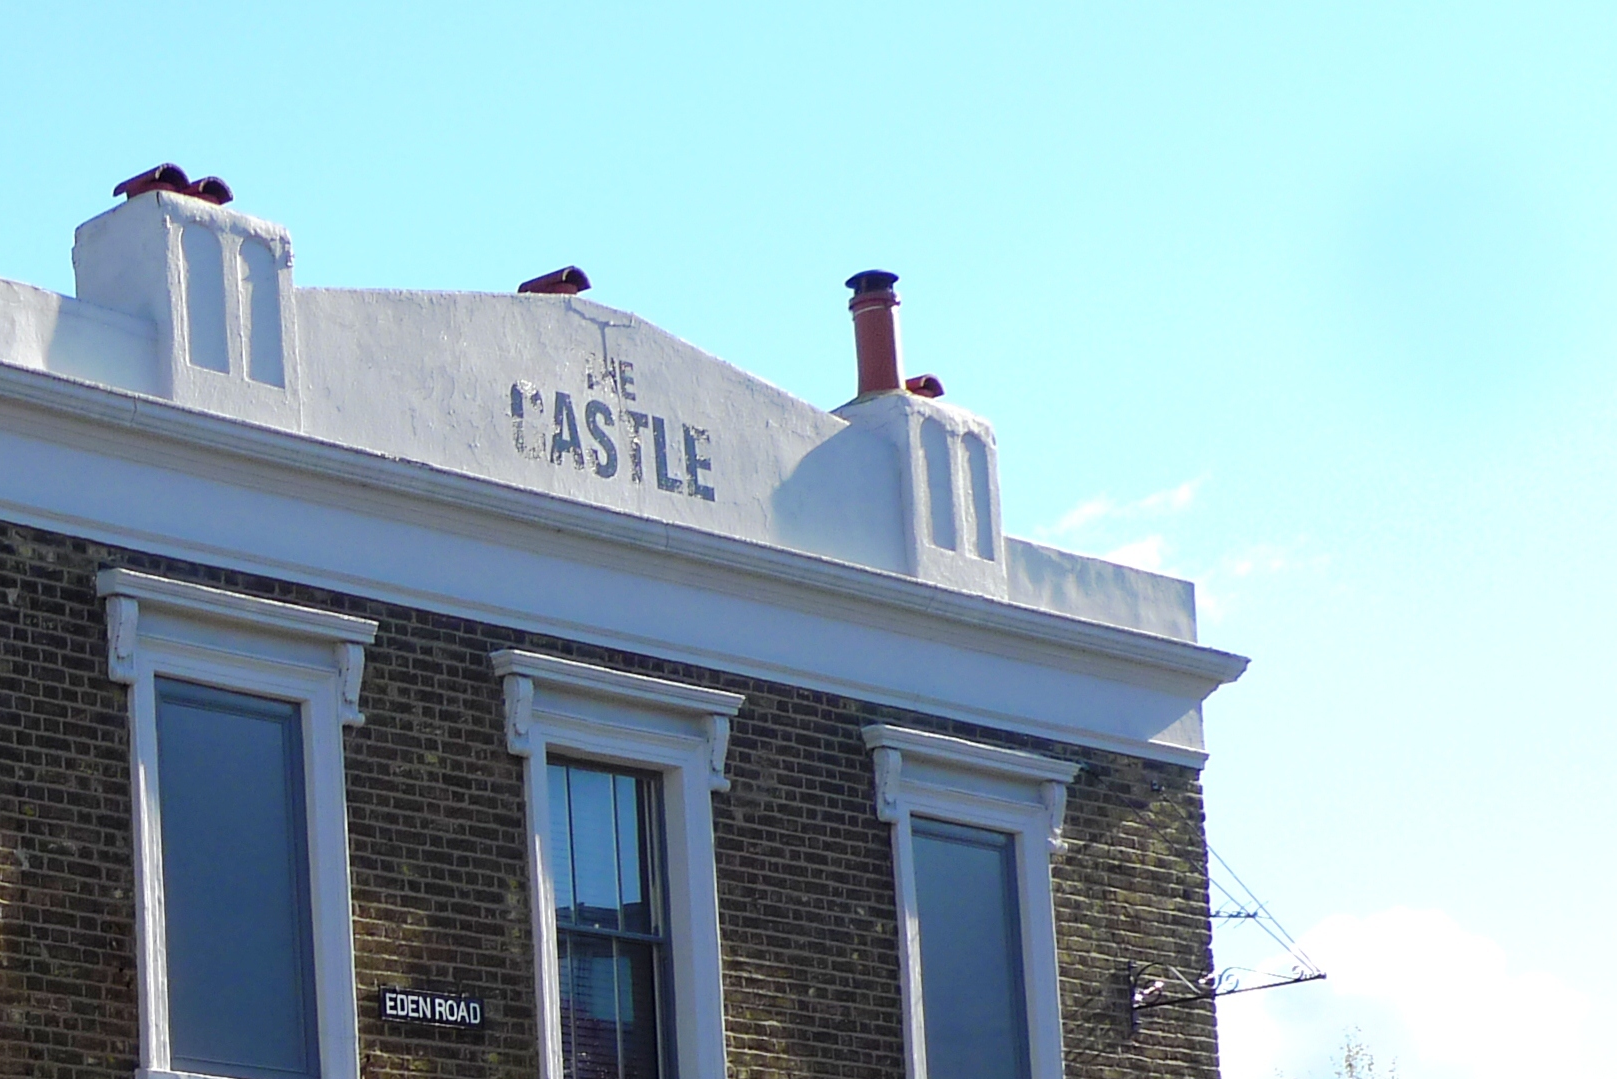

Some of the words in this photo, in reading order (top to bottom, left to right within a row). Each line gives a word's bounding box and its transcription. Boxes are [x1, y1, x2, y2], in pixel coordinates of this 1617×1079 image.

[510, 380, 715, 502] CASTLE
[385, 992, 432, 1019] EDEN
[435, 998, 481, 1024] ROAD
